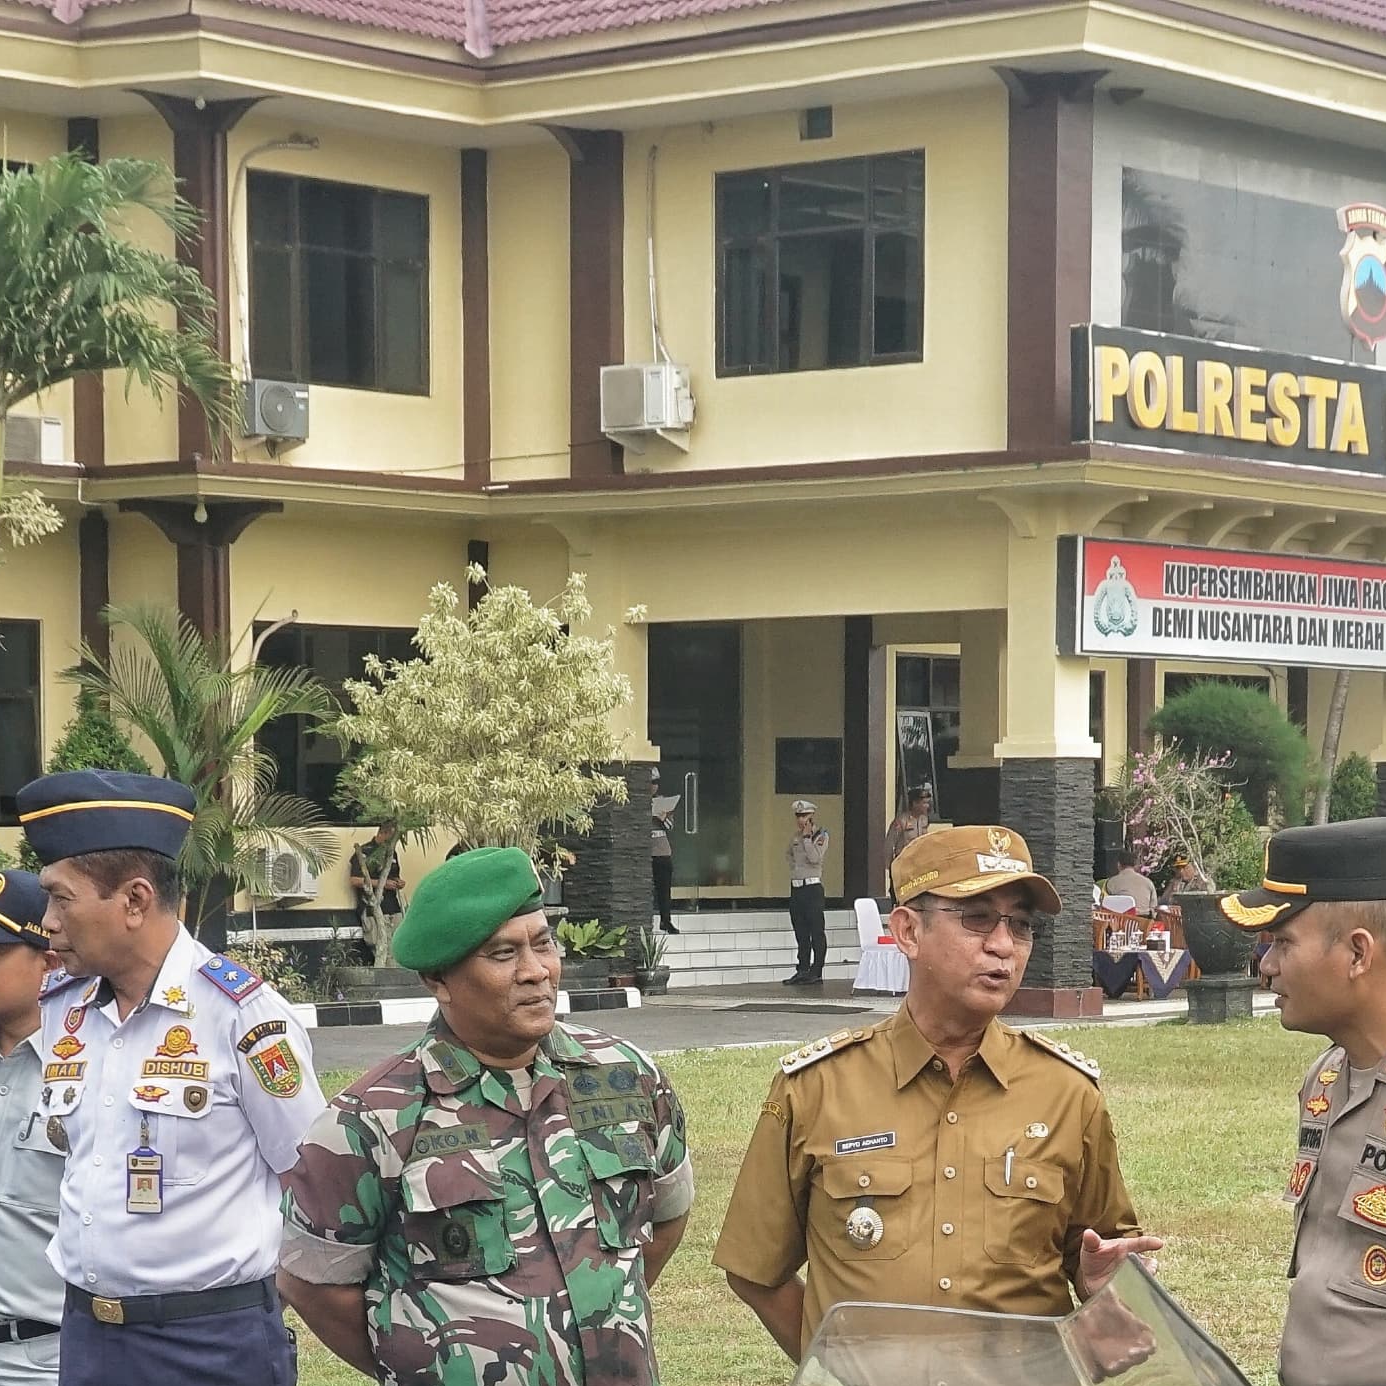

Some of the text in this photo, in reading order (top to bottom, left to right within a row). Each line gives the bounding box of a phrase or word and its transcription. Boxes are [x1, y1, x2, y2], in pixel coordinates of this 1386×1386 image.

[1094, 345, 1369, 455] POLRESTA
[1164, 563, 1317, 604] KUPERSEMBAHKAN
[1320, 577, 1358, 609] JIWA
[1152, 607, 1194, 640] DEMI
[1198, 612, 1293, 645] NUSANTARA
[1297, 618, 1328, 648] DAN
[1332, 621, 1384, 651] MERAH
[145, 1061, 205, 1077] DISHUB
[578, 1104, 616, 1124] TNI
